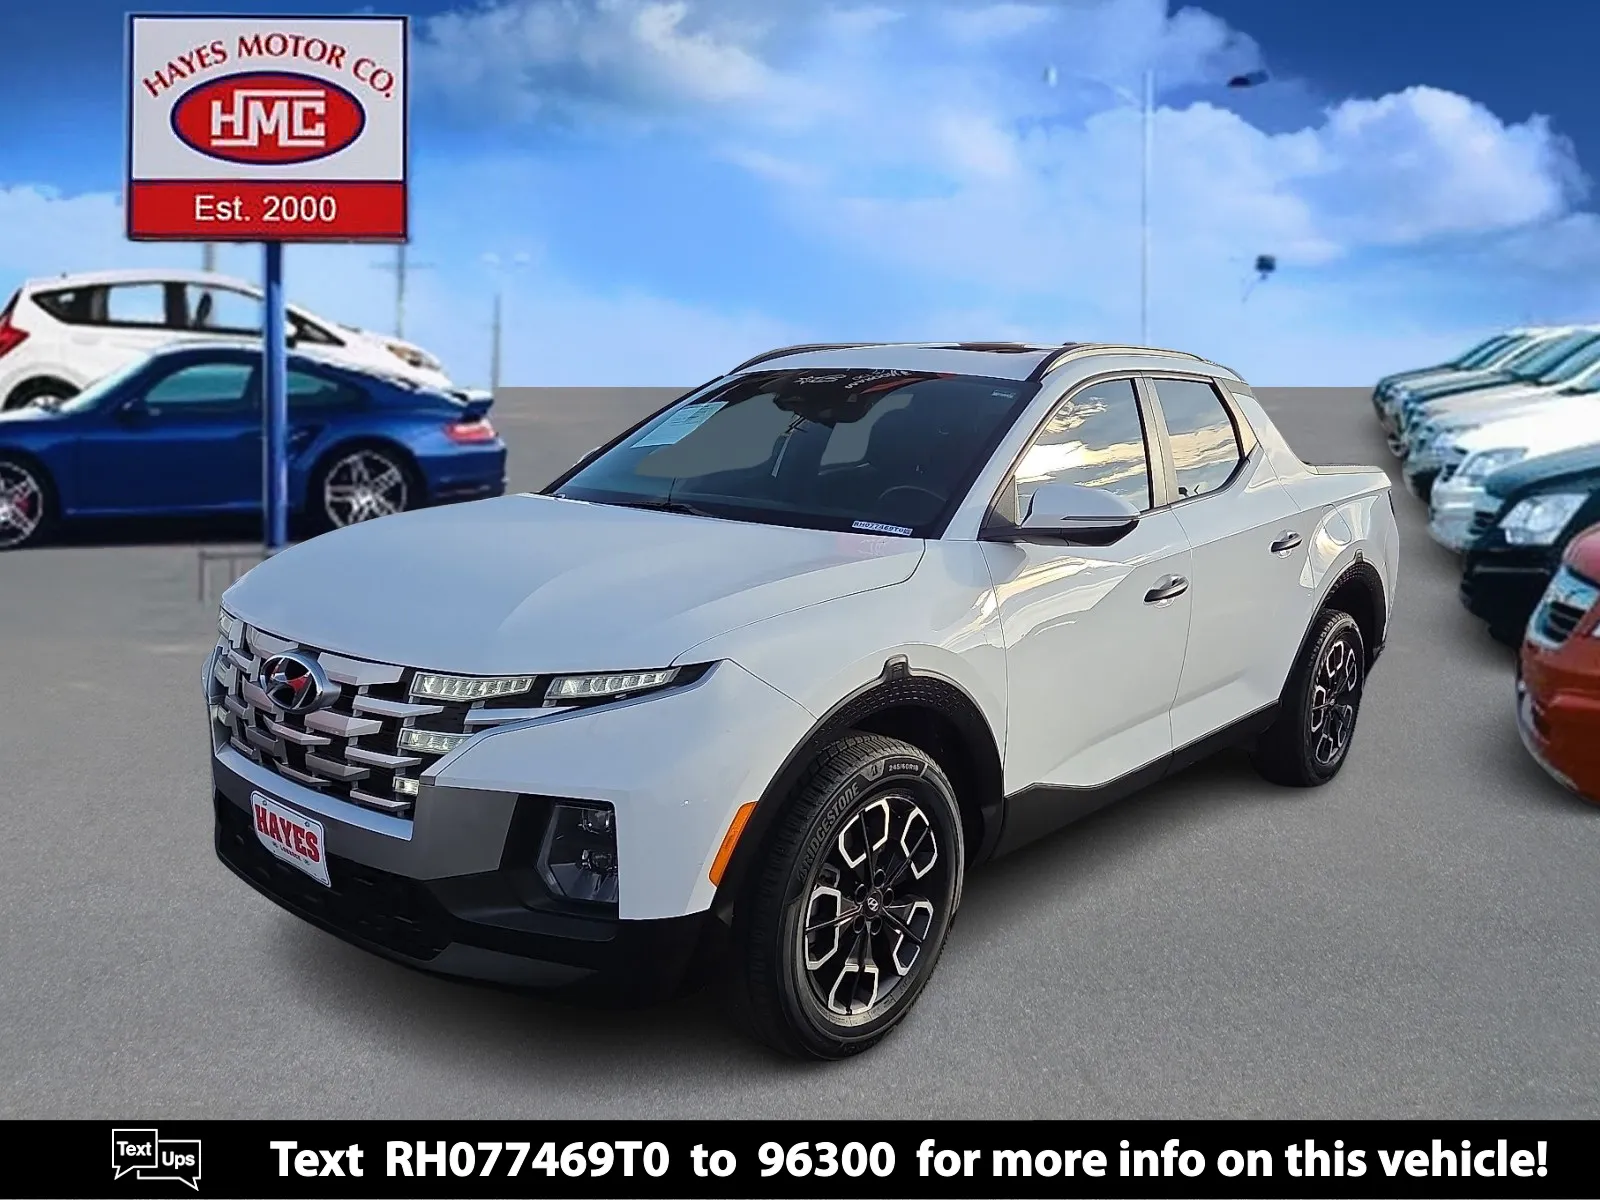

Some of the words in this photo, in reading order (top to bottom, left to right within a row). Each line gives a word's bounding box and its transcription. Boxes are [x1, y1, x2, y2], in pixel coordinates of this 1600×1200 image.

[142, 40, 228, 98] HAYES
[237, 33, 346, 69] MOTOR
[352, 57, 394, 98] CO.
[210, 89, 326, 147] HMC
[195, 194, 250, 221] Est.
[263, 195, 337, 221] 2000
[254, 803, 320, 863] HAYES
[799, 782, 860, 880] BRIDGESTONE
